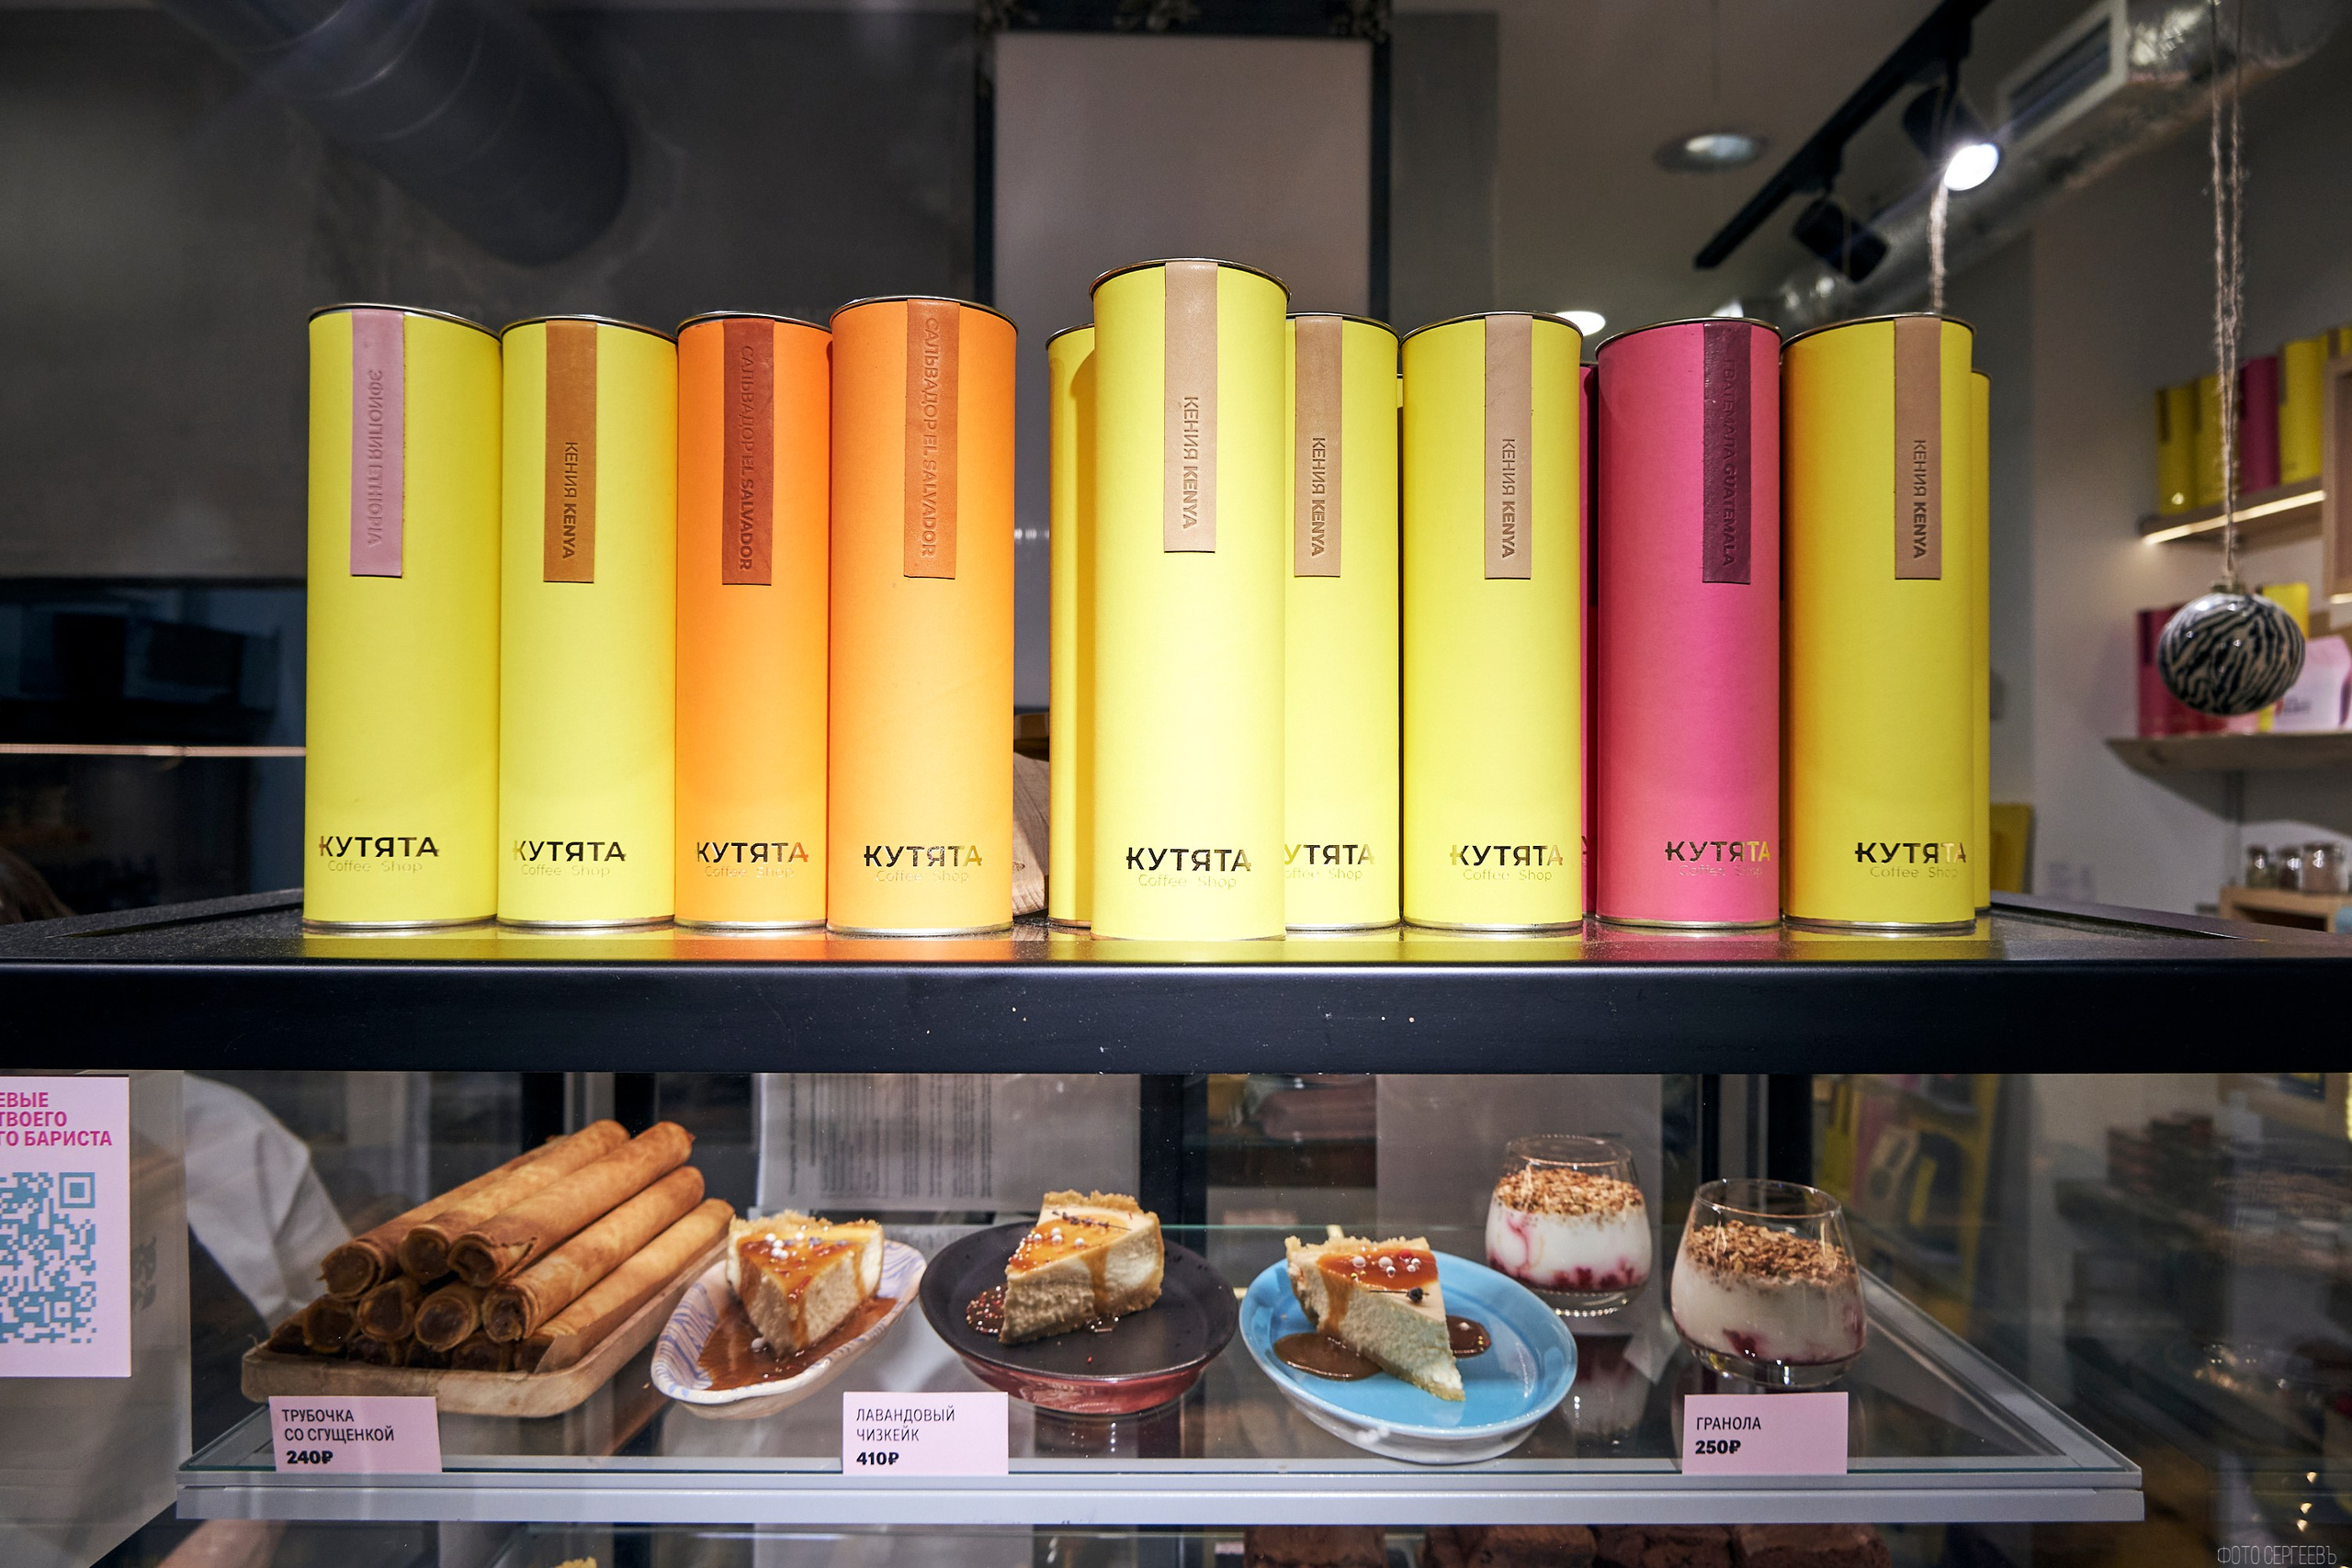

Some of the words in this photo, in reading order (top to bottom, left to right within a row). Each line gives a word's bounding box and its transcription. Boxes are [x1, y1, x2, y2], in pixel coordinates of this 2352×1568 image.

[922, 318, 939, 430] САЛЬВАДОР
[738, 344, 754, 455] САЛЬВАДОР
[1723, 359, 1736, 459] ГВАТЕМАЛА
[368, 369, 383, 461] ЭФИОПИЯ
[1183, 396, 1199, 459] КЕНИЯ
[922, 434, 938, 457] EL
[564, 442, 579, 498] КЕНИЯ
[740, 457, 753, 475] EL
[1312, 437, 1326, 494] КЕНИЯ
[1502, 438, 1516, 495] КЕНИЯ
[1913, 440, 1927, 496] КЕНИЯ
[368, 463, 383, 547] ETHIOPIA
[922, 459, 937, 558] SALVADOR
[1182, 466, 1197, 529] KENYA
[739, 478, 753, 570] SALVADOR
[1723, 463, 1736, 566] GUATEMALA
[562, 502, 578, 558] KENYA
[1311, 499, 1325, 557] KENYA
[1502, 501, 1515, 558] KENYA
[1913, 502, 1927, 559] KENYA
[319, 835, 439, 857] КУТЯТА
[513, 840, 627, 862] КУТЯТА
[696, 841, 808, 863] КУТЯТА
[864, 845, 983, 867] КУТЯТА
[1284, 844, 1375, 865] УТЯТА
[1450, 844, 1564, 866] КУТЯТА
[1664, 840, 1771, 862] КУТЯТА
[1855, 842, 1966, 863] КУТЯТА
[327, 860, 371, 873] Coffee
[381, 860, 423, 874] Shop
[521, 863, 561, 875] Coffee
[571, 864, 611, 877] Shop
[1126, 847, 1252, 872] КУТЯТА
[705, 865, 747, 877] Coffee
[756, 866, 795, 879] Shop
[876, 870, 922, 883] Coffee
[933, 870, 969, 884] Shop
[1137, 874, 1188, 887] Coffee
[1197, 874, 1238, 890] Shop
[1284, 868, 1320, 879] offee
[1329, 868, 1363, 881] Shop
[1463, 869, 1510, 881] Coffee
[1519, 869, 1552, 883] Shop
[1679, 864, 1726, 876] Coffee
[1734, 864, 1763, 878] Shop
[1870, 866, 1919, 878] Coffee
[1928, 866, 1958, 879] Shop
[24, 1131, 112, 1146] БАРИСТА
[282, 1409, 355, 1422] ТРУБОЧКА
[856, 1405, 956, 1424] ЛАВАНДОВЫЙ
[1696, 1416, 1761, 1430] ГРАНОЛА
[284, 1427, 304, 1441] СО
[307, 1425, 395, 1444] СГУЩЕНКОЙ
[856, 1426, 920, 1442] ЧИЗКЕЙК
[286, 1450, 334, 1464] 240₽
[1695, 1439, 1741, 1454] 250₽
[856, 1451, 899, 1465] 410₽
